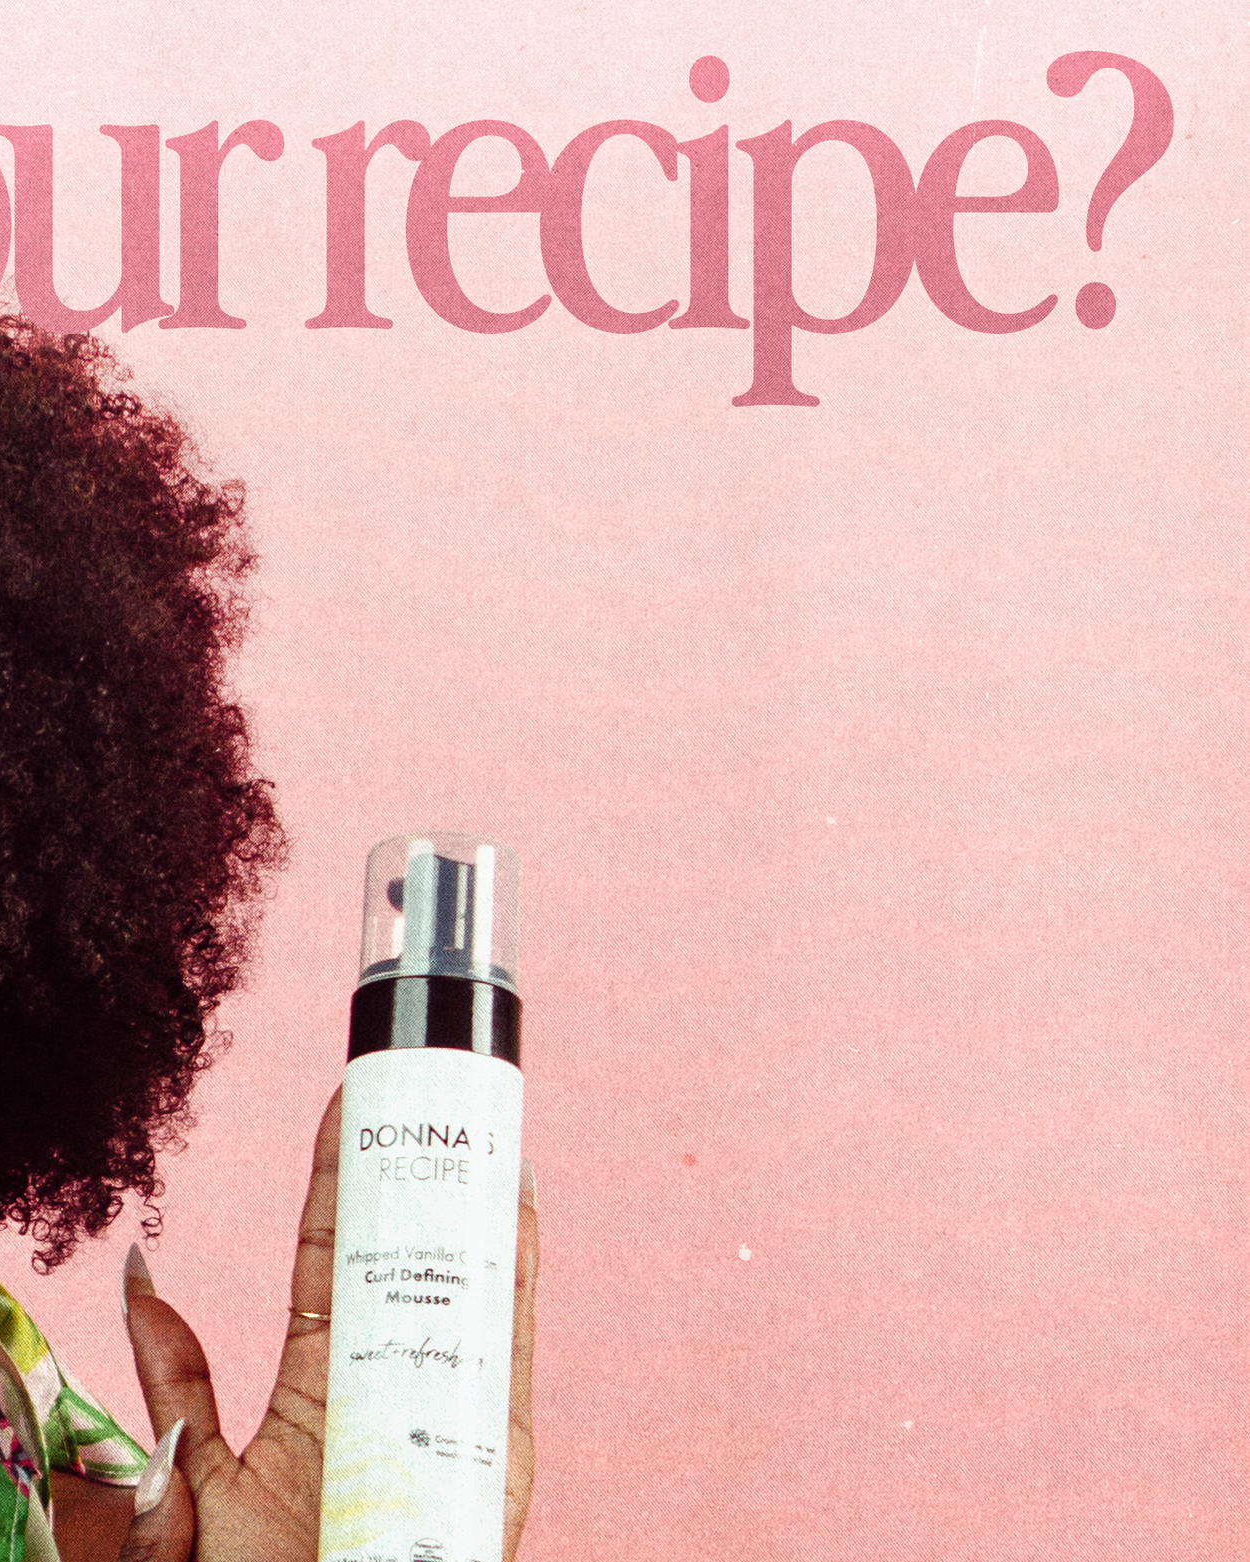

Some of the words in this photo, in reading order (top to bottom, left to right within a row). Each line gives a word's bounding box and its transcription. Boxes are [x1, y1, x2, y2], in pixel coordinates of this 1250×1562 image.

[360, 1124, 494, 1154] DONNA
[380, 1157, 469, 1185] RECIPE
[365, 1267, 395, 1283] Curl
[400, 1269, 470, 1290] Defining
[385, 1291, 451, 1306] Mousse
